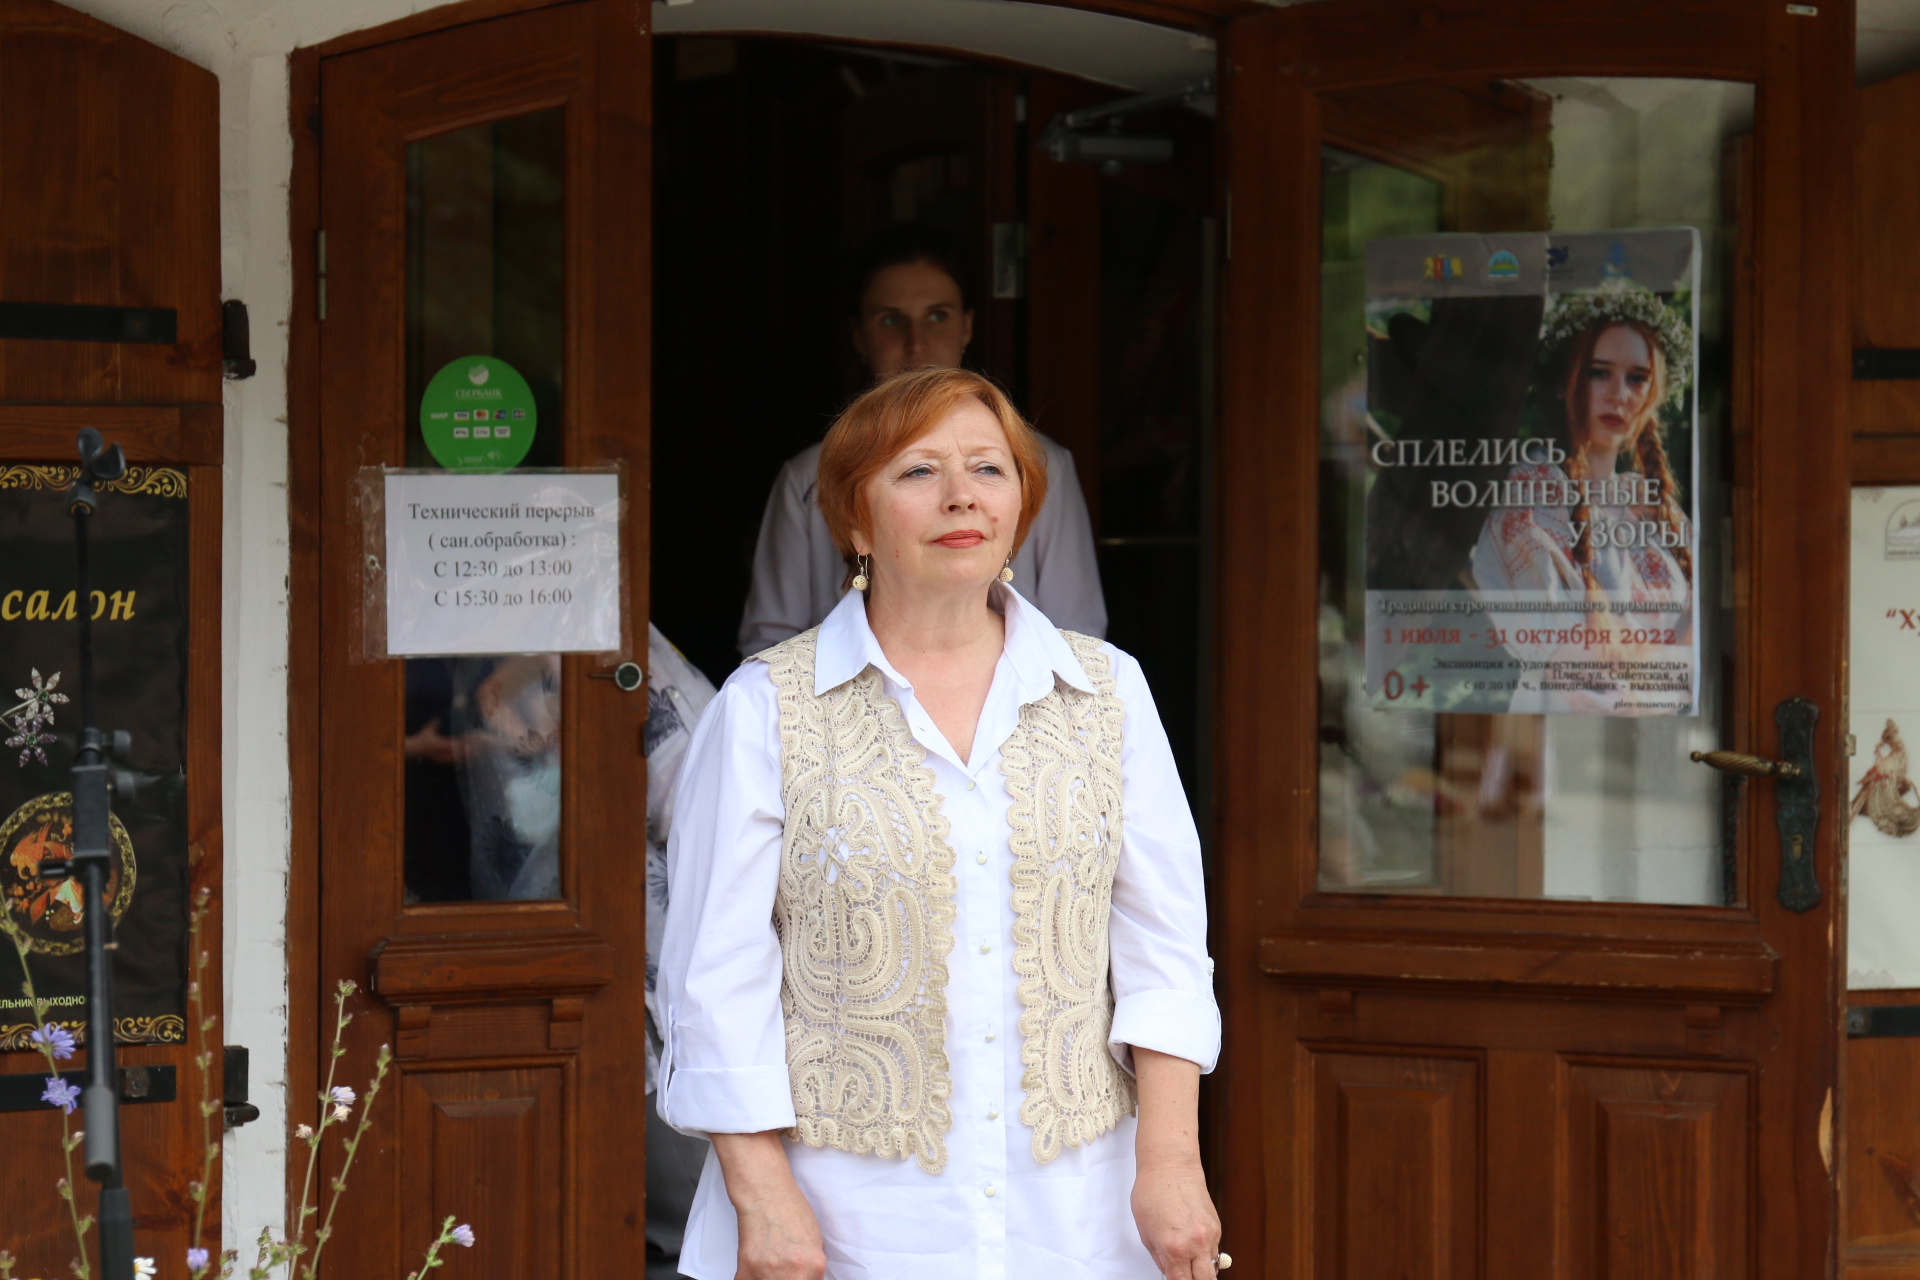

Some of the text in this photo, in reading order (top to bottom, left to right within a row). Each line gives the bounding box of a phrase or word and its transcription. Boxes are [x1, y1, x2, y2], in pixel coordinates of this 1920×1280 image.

[455, 388, 502, 398] СБЕРБАНК
[1372, 438, 1567, 467] СПЛЕЛИСЬ
[1431, 478, 1663, 508] ВОЛШЕБНЫЕ
[408, 503, 596, 522] Технический перерыв
[1566, 520, 1689, 550] УЗОРЫ
[433, 559, 572, 578] С 12:30 до 13:00
[434, 588, 573, 607] С 15:30 до 16:00
[1384, 627, 1393, 645] 1
[1400, 627, 1462, 645] июля
[1484, 627, 1508, 650] 31
[1515, 623, 1612, 651] октября
[1620, 627, 1677, 645] 2022
[1433, 657, 1504, 670] Экспозиция
[1488, 681, 1503, 691] до
[1540, 680, 1618, 692] понедельник
